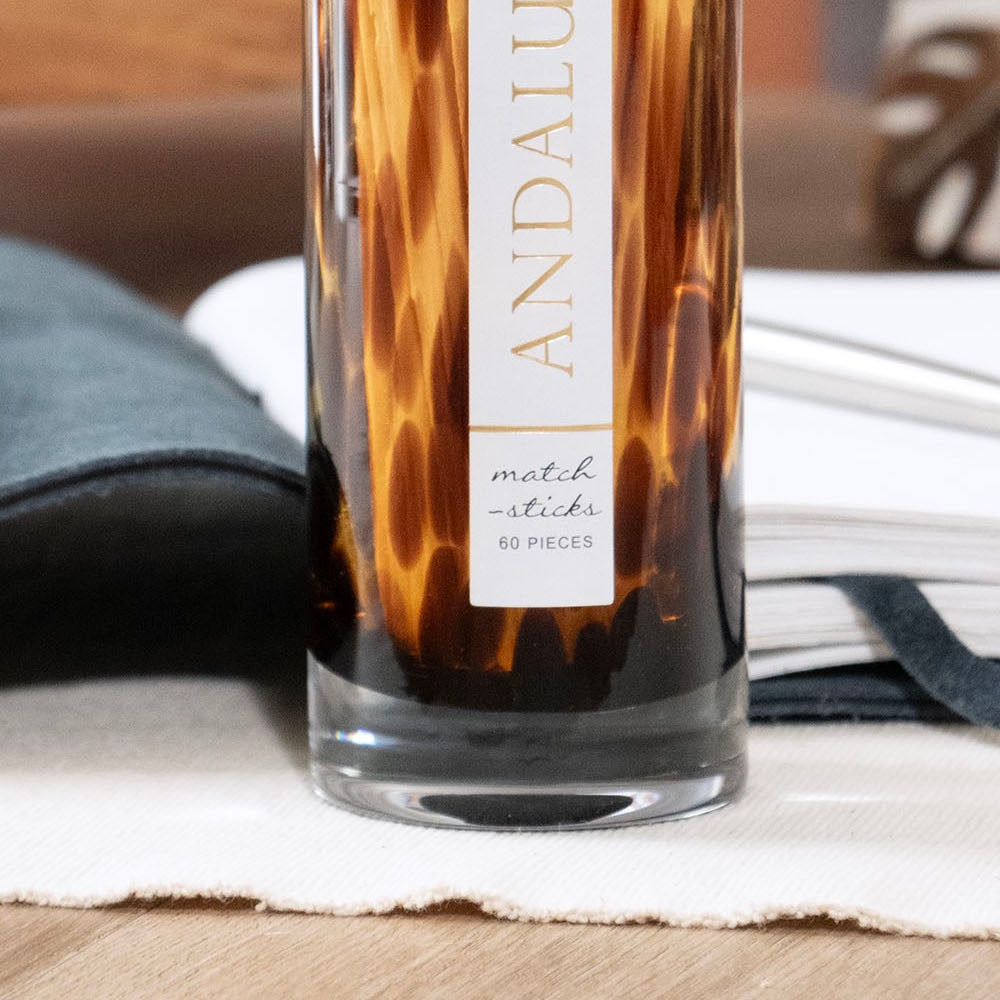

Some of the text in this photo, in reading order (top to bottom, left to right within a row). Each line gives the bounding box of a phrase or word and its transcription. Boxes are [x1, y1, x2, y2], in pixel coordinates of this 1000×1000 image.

[491, 456, 597, 482] match
[488, 494, 602, 518] -sticks
[499, 535, 593, 550] 60 PIECES
